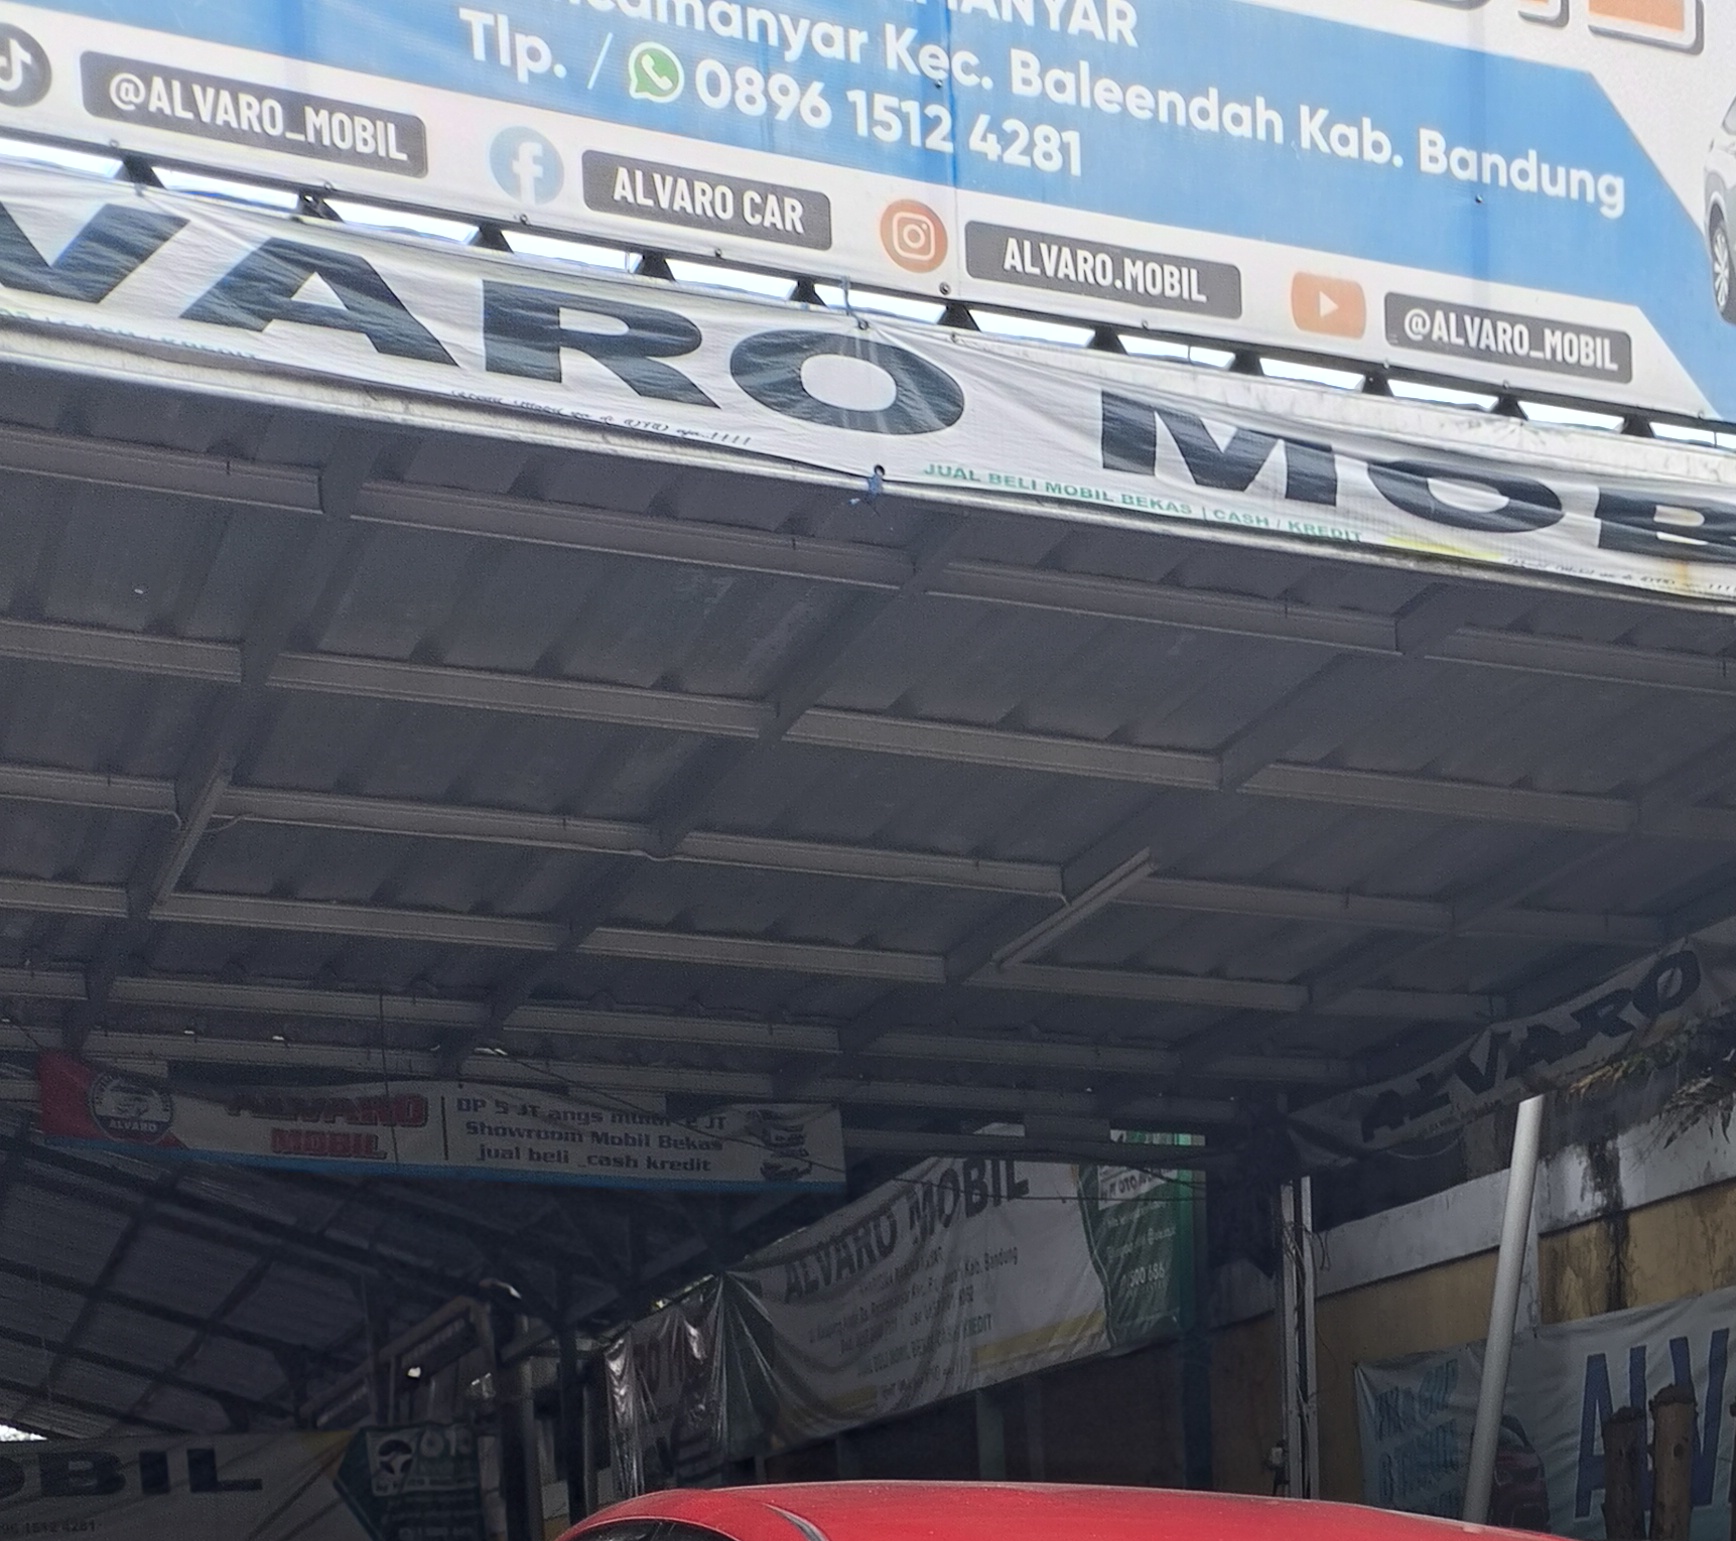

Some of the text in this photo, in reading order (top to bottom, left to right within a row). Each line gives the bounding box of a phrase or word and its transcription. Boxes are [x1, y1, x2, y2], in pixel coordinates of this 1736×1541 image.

[109, 72, 408, 162] @ALVARO_MOBIL
[459, 8, 568, 84] Tlp.
[695, 58, 833, 129] 0896
[846, 88, 953, 154] 1512
[968, 113, 1082, 177] 4281
[884, 23, 993, 90] Kec.
[1010, 48, 1284, 145] Baleendah
[1300, 104, 1404, 168] Kab.
[1419, 127, 1625, 219] Bandung
[613, 166, 805, 235] ALVARO CAR
[1003, 236, 1208, 304] ALVARO.MOBIL
[1403, 308, 1619, 372] @ALVARO_MOBIL
[923, 462, 982, 483] JUAL
[988, 471, 1038, 492] BELI
[1044, 479, 1115, 503] MOBIL
[1121, 491, 1193, 516] BEKAS
[1213, 509, 1270, 529] CASH
[1287, 520, 1364, 543] KREDIT
[464, 1120, 724, 1152] Showroom Mobil Bekas
[476, 1143, 521, 1162] jual
[526, 1147, 570, 1165] beli
[646, 1154, 712, 1173] kredit
